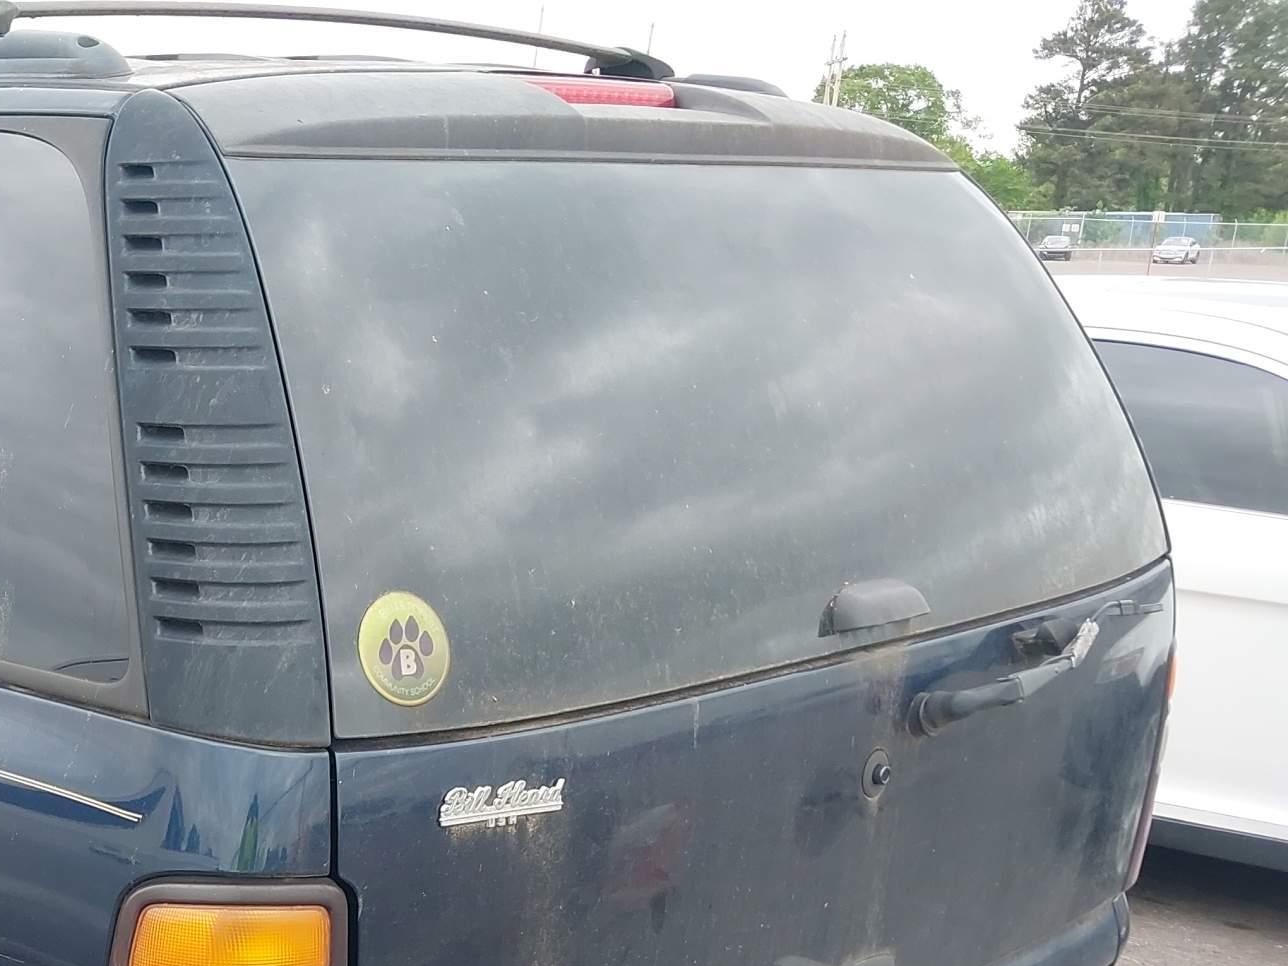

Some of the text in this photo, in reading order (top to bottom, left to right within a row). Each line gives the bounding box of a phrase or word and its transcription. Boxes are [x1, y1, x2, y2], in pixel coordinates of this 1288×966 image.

[400, 648, 417, 676] B
[409, 677, 436, 697] SCHOOL
[441, 778, 566, 816] Bill Heard
